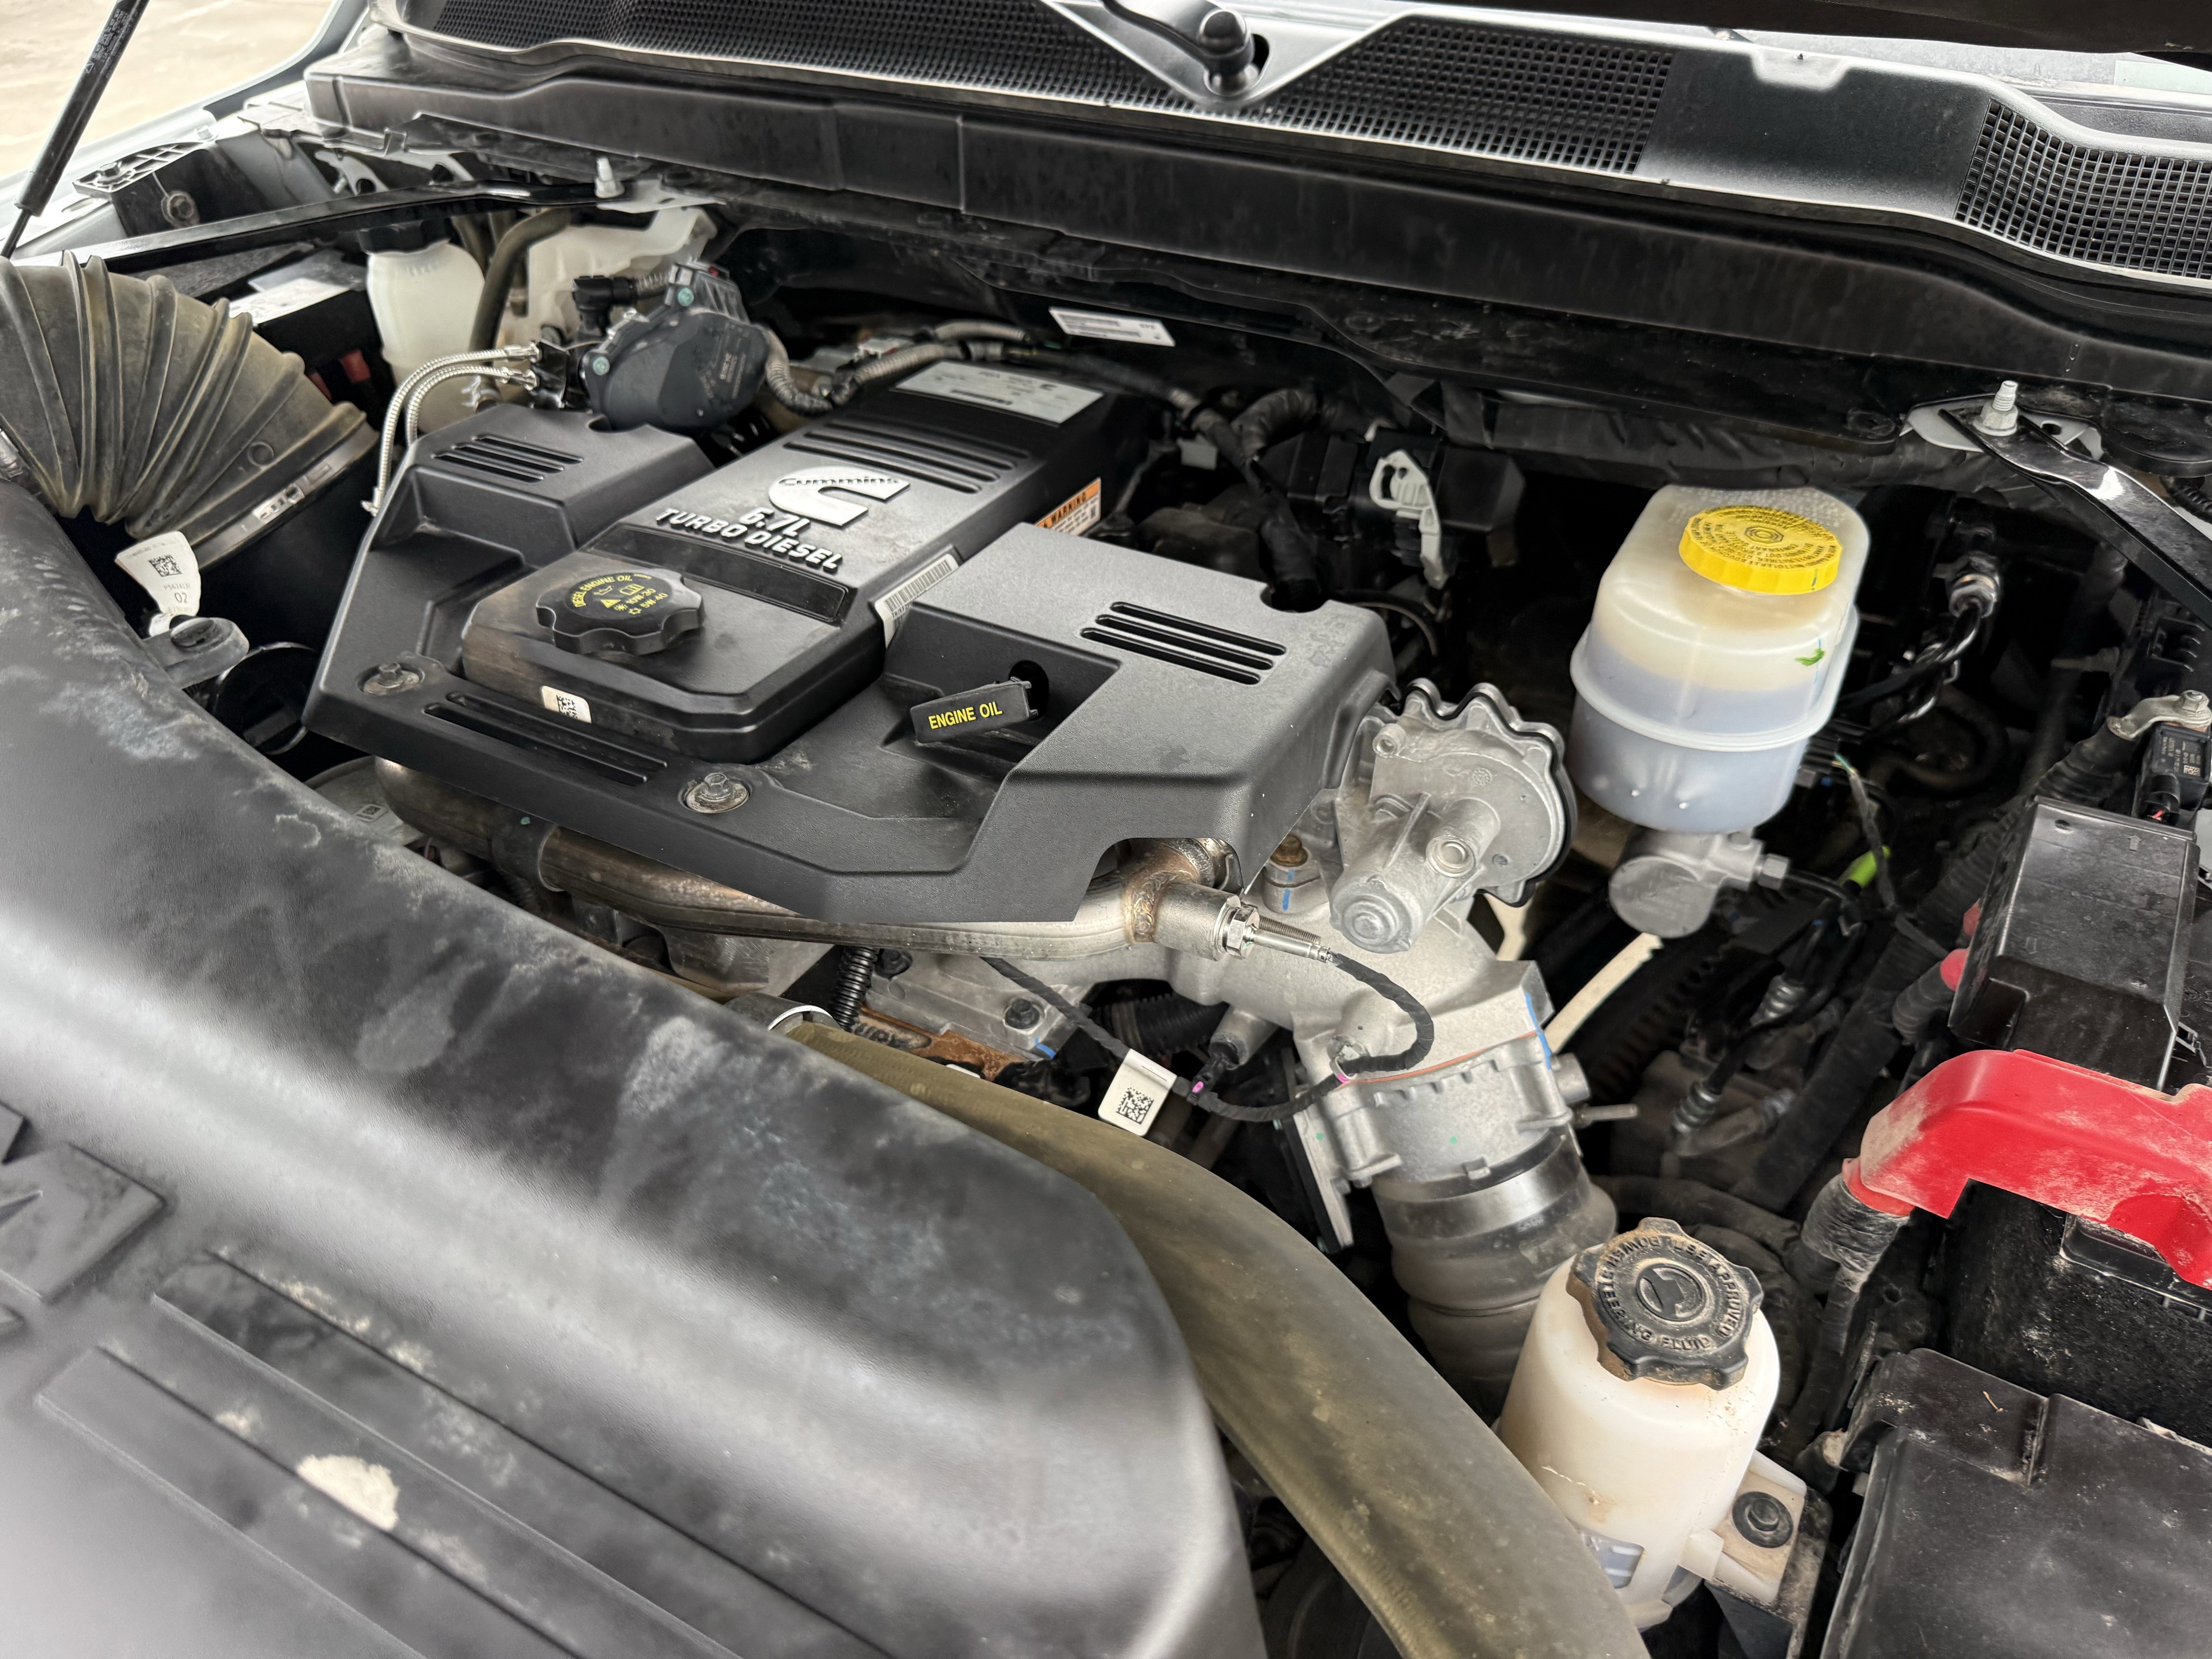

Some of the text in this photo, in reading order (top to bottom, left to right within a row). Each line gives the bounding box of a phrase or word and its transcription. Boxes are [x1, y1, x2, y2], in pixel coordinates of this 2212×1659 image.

[779, 476, 899, 486] Cummins
[1051, 491, 1086, 523] WARNING
[739, 507, 811, 538] 6.7L
[655, 508, 843, 571] TURBO DIESEL
[579, 577, 615, 591] ENGINE
[175, 591, 188, 604] 02
[572, 591, 587, 607] DIESEL
[625, 588, 656, 604] 10W-30
[640, 593, 668, 608] 5W-40
[928, 701, 1003, 730] ENGINE OIL
[1662, 1335, 1711, 1351] FLUID
